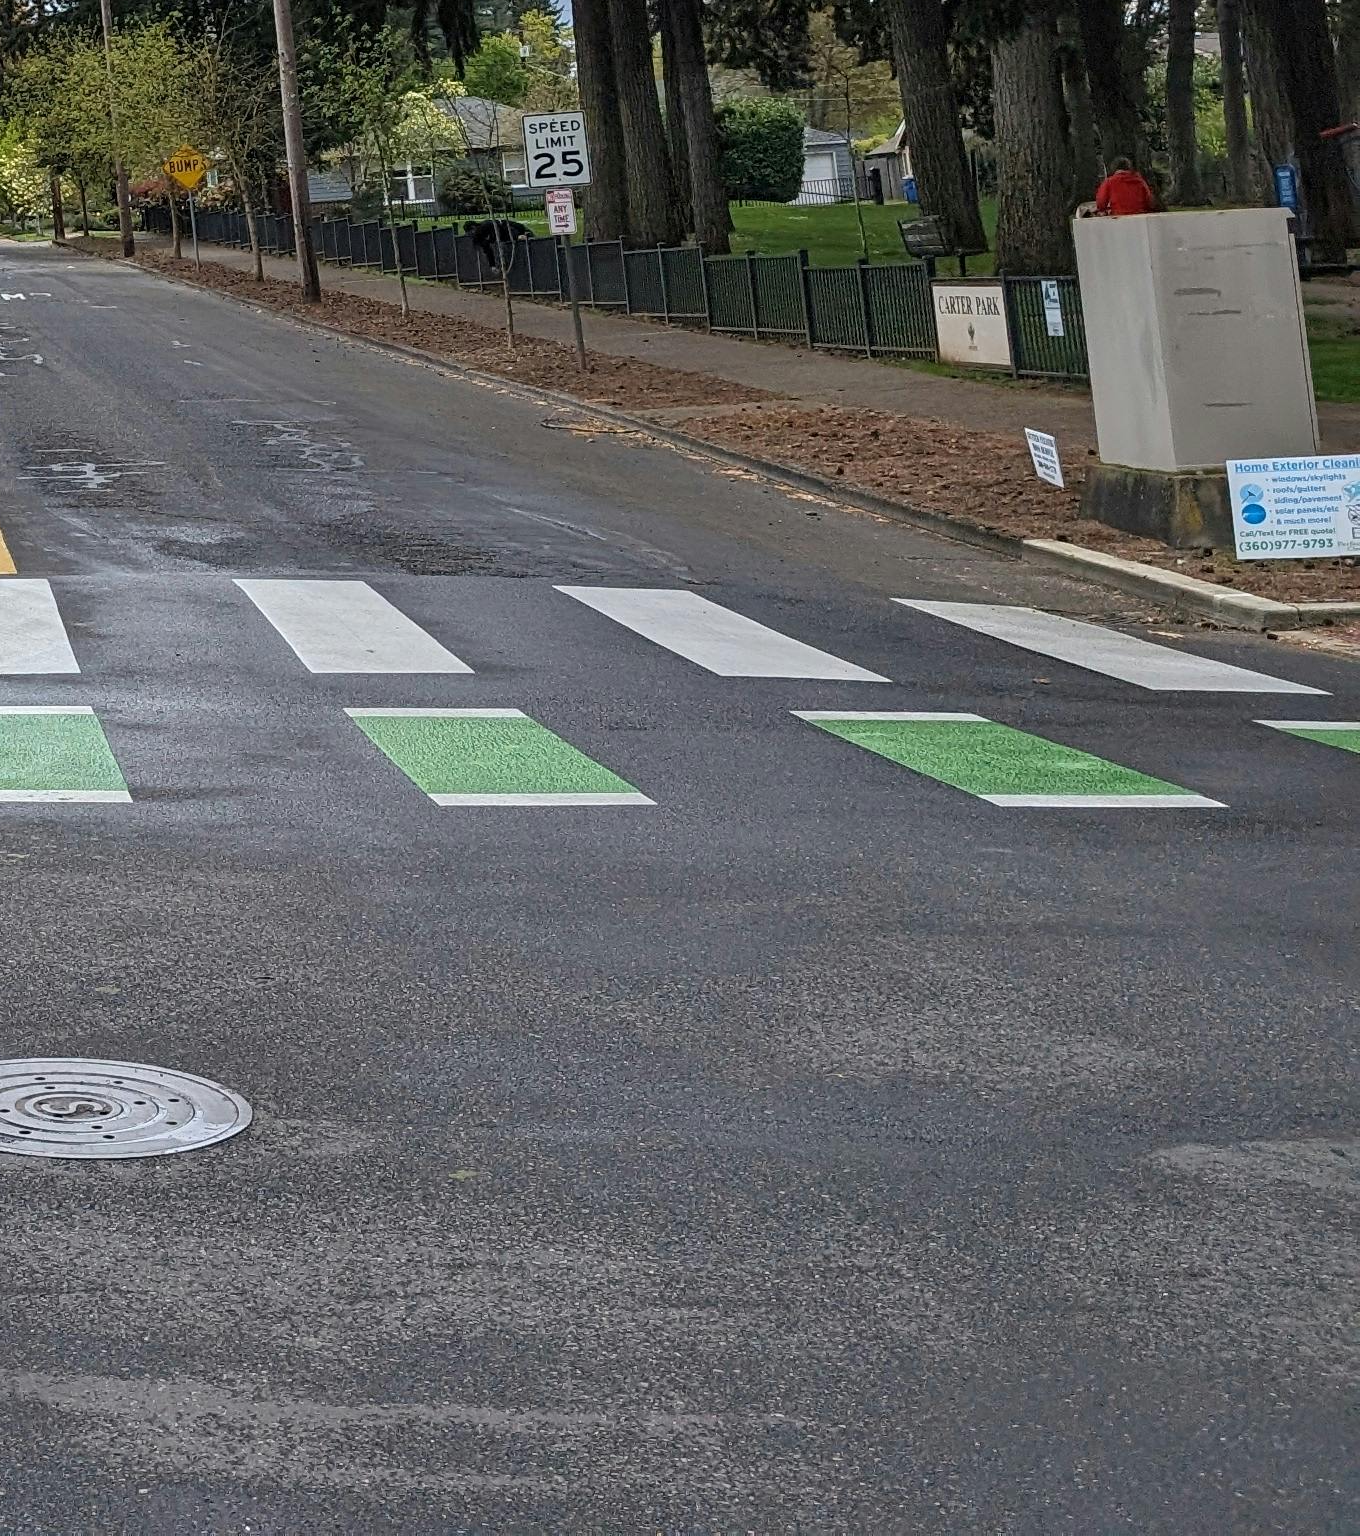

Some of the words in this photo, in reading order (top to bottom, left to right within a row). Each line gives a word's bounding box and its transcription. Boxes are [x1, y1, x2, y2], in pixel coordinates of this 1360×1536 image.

[528, 120, 580, 134] SPEED
[535, 135, 576, 149] LIMIT
[169, 159, 199, 174] BUMP
[533, 150, 584, 179] 25
[553, 205, 568, 213] ANY
[553, 214, 570, 223] TIME
[938, 295, 973, 315] CARTER
[975, 296, 1000, 316] PARK
[1235, 462, 1269, 473] Home
[1272, 459, 1319, 471] Exterior
[1271, 473, 1346, 482] windows/skylights
[1272, 485, 1326, 494] roofs/gutters
[1274, 495, 1342, 505] siding/pavement
[1275, 507, 1294, 515] solar
[1308, 516, 1331, 524] more!
[1239, 530, 1274, 538] Call/Text
[1288, 528, 1309, 536] FREE
[1310, 527, 1336, 536] quote!
[1239, 538, 1334, 552] (360)977-9793
